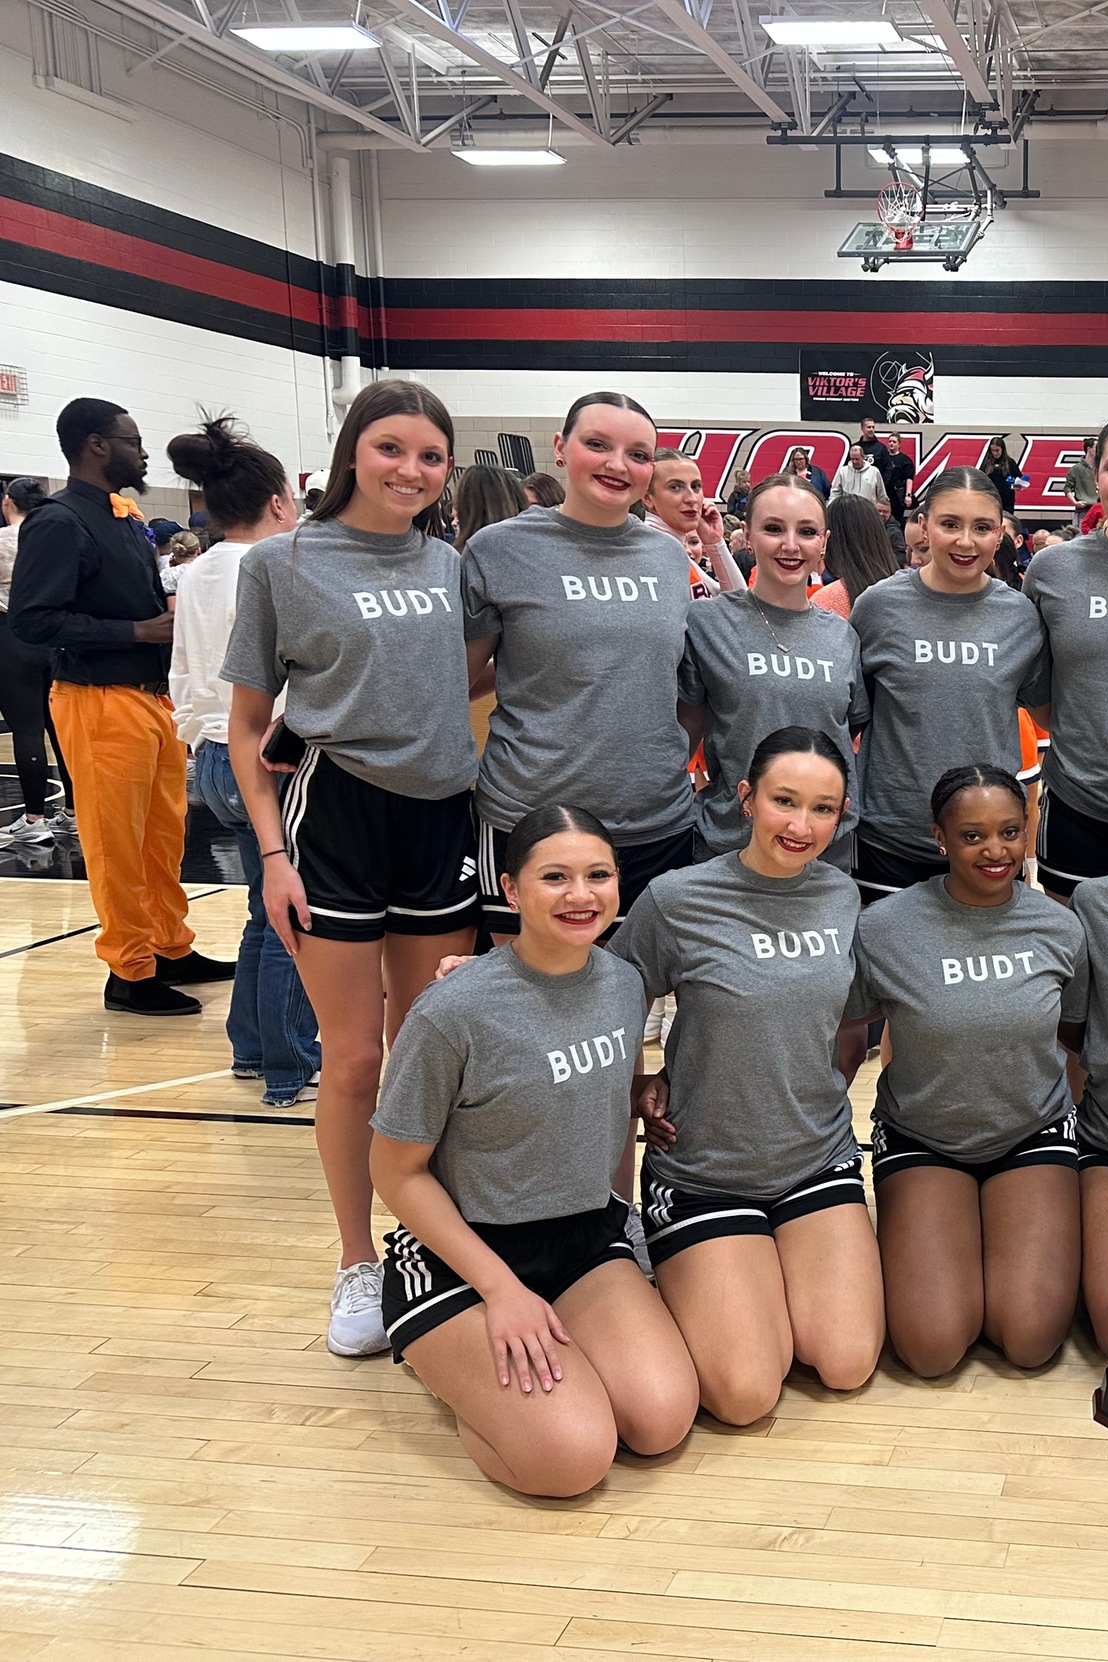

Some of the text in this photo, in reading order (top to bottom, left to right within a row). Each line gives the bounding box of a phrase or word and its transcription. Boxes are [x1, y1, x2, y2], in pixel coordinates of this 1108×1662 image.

[807, 376, 867, 387] VIKTOR'S
[808, 386, 866, 397] VILLAGE
[352, 586, 453, 620] BUDT
[560, 575, 659, 602] BUDT
[746, 651, 834, 683] BUDT
[914, 639, 999, 667] BUDT
[750, 927, 842, 959] BUDT
[941, 950, 1035, 985] BUDT
[546, 1027, 627, 1084] BUDT
